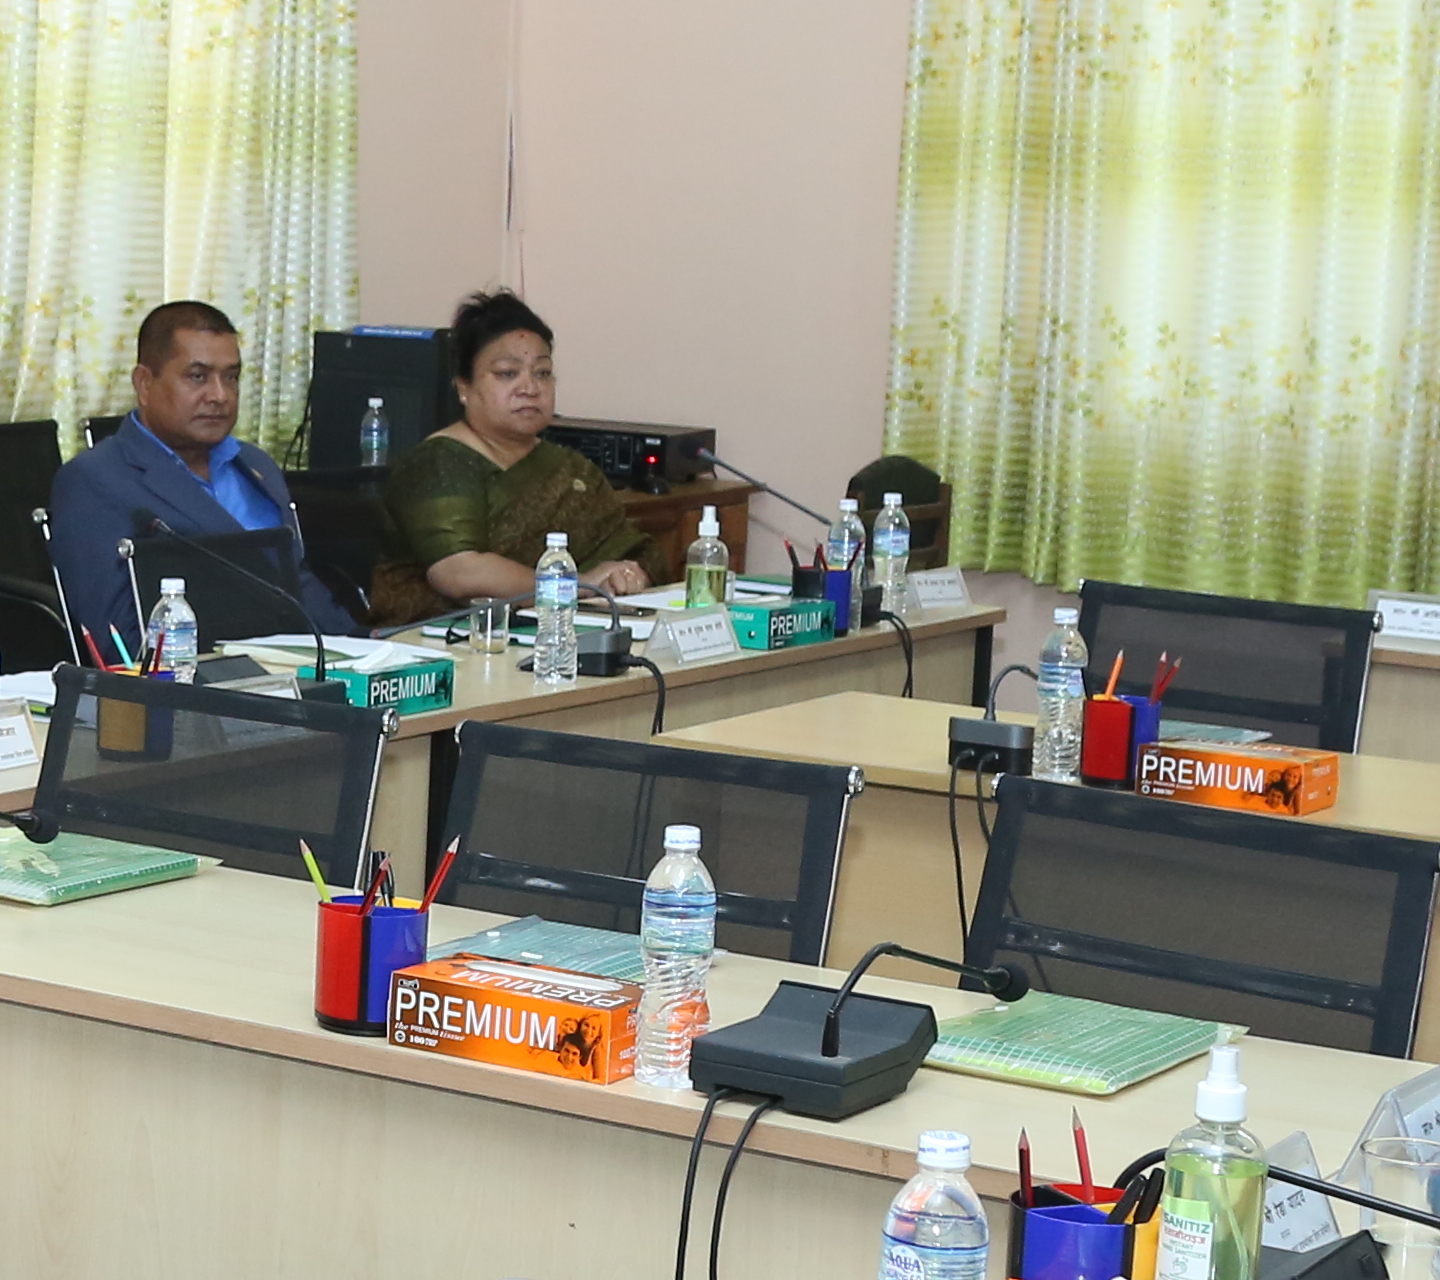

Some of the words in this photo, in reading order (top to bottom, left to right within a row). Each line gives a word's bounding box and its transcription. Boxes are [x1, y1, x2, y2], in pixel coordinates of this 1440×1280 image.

[771, 611, 822, 637] PREMIUM
[371, 672, 436, 706] PREMIUM
[1141, 754, 1265, 794] PREMIUM
[395, 986, 557, 1051] PREMIUM
[1164, 1212, 1211, 1234] SANITIZ
[888, 1252, 923, 1273] AQUA
